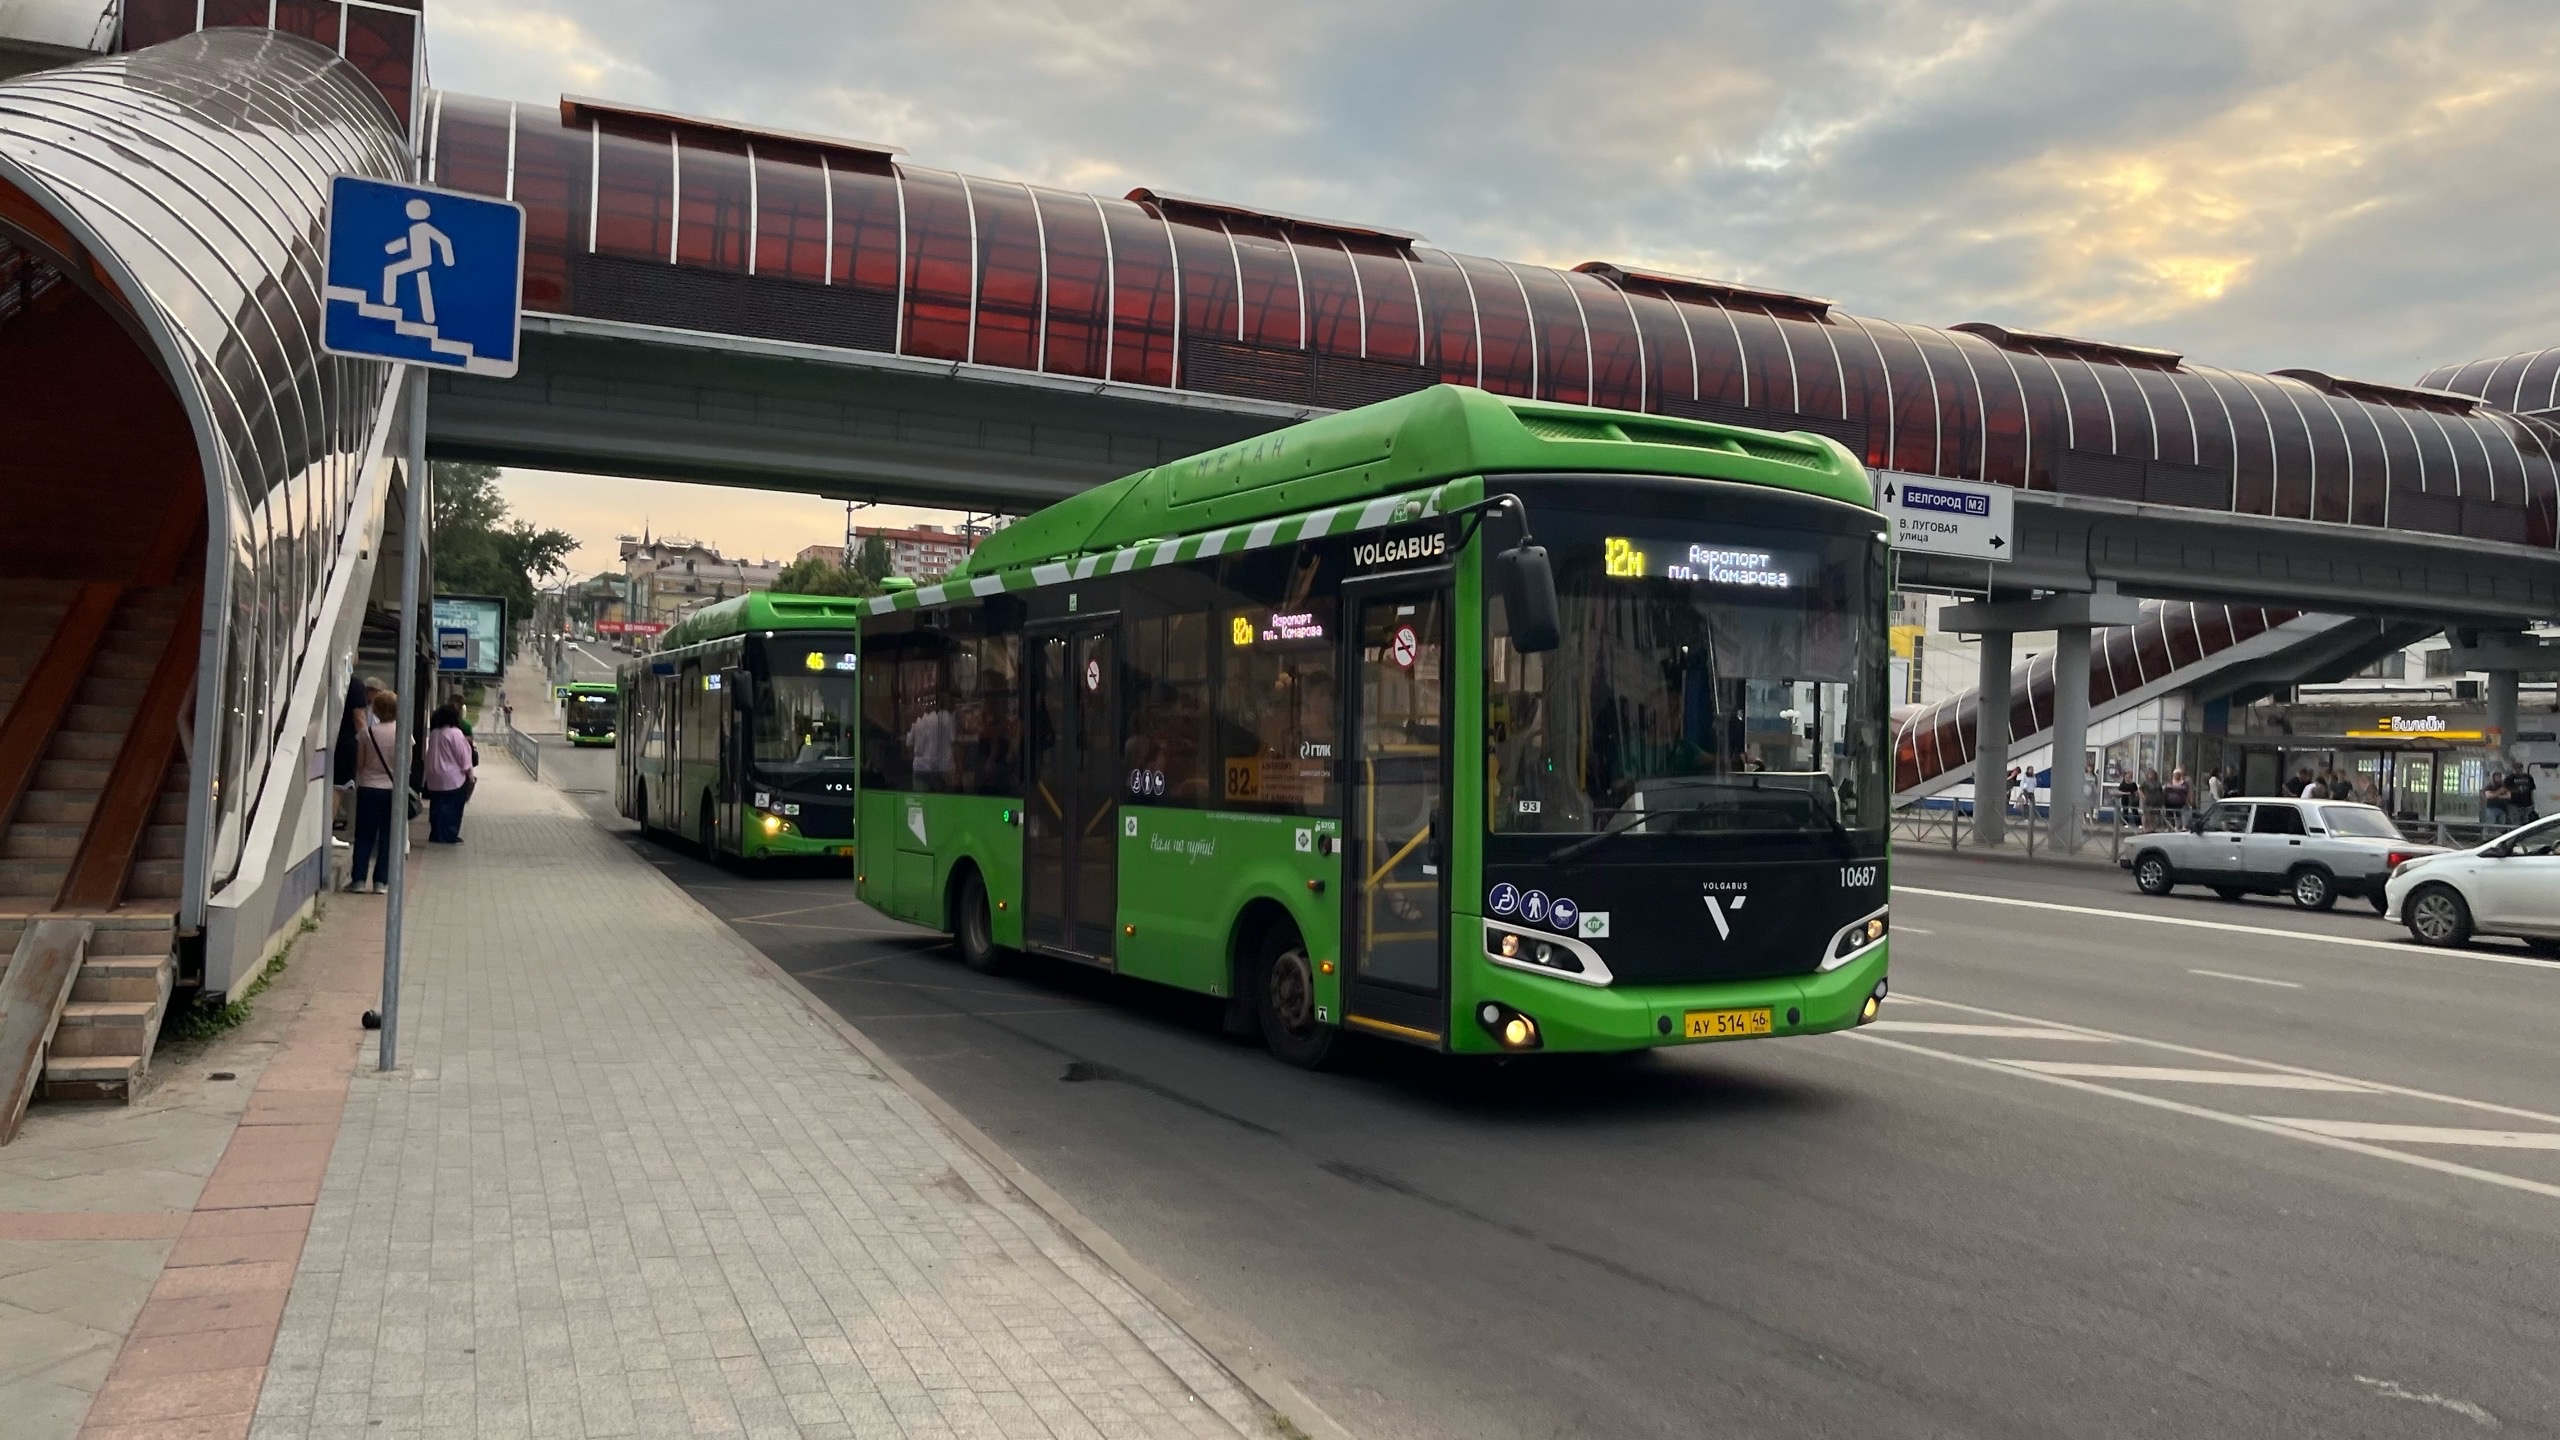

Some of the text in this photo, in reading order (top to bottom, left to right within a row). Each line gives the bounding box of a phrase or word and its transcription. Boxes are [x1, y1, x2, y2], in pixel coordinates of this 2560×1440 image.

[1907, 491, 1962, 510] БЕЛГОРОД
[1899, 518, 1958, 534] В. ЛУГОВАЯ
[1899, 532, 1929, 543] улица
[1353, 532, 1446, 567] VOLGABUS
[1688, 544, 1771, 569] Аэропорт
[1668, 562, 1789, 588] пл. Комарова
[1272, 613, 1313, 628] Аэропорт
[1281, 625, 1323, 639] Комарова
[1310, 744, 1332, 757] ГТЛК
[1522, 801, 1538, 812] 93
[1840, 866, 1877, 888] 10687
[1702, 882, 1748, 890] VOLGABUS
[1587, 920, 1601, 929] КПГ
[1717, 1014, 1745, 1034] 514
[1752, 1012, 1766, 1026] 46
